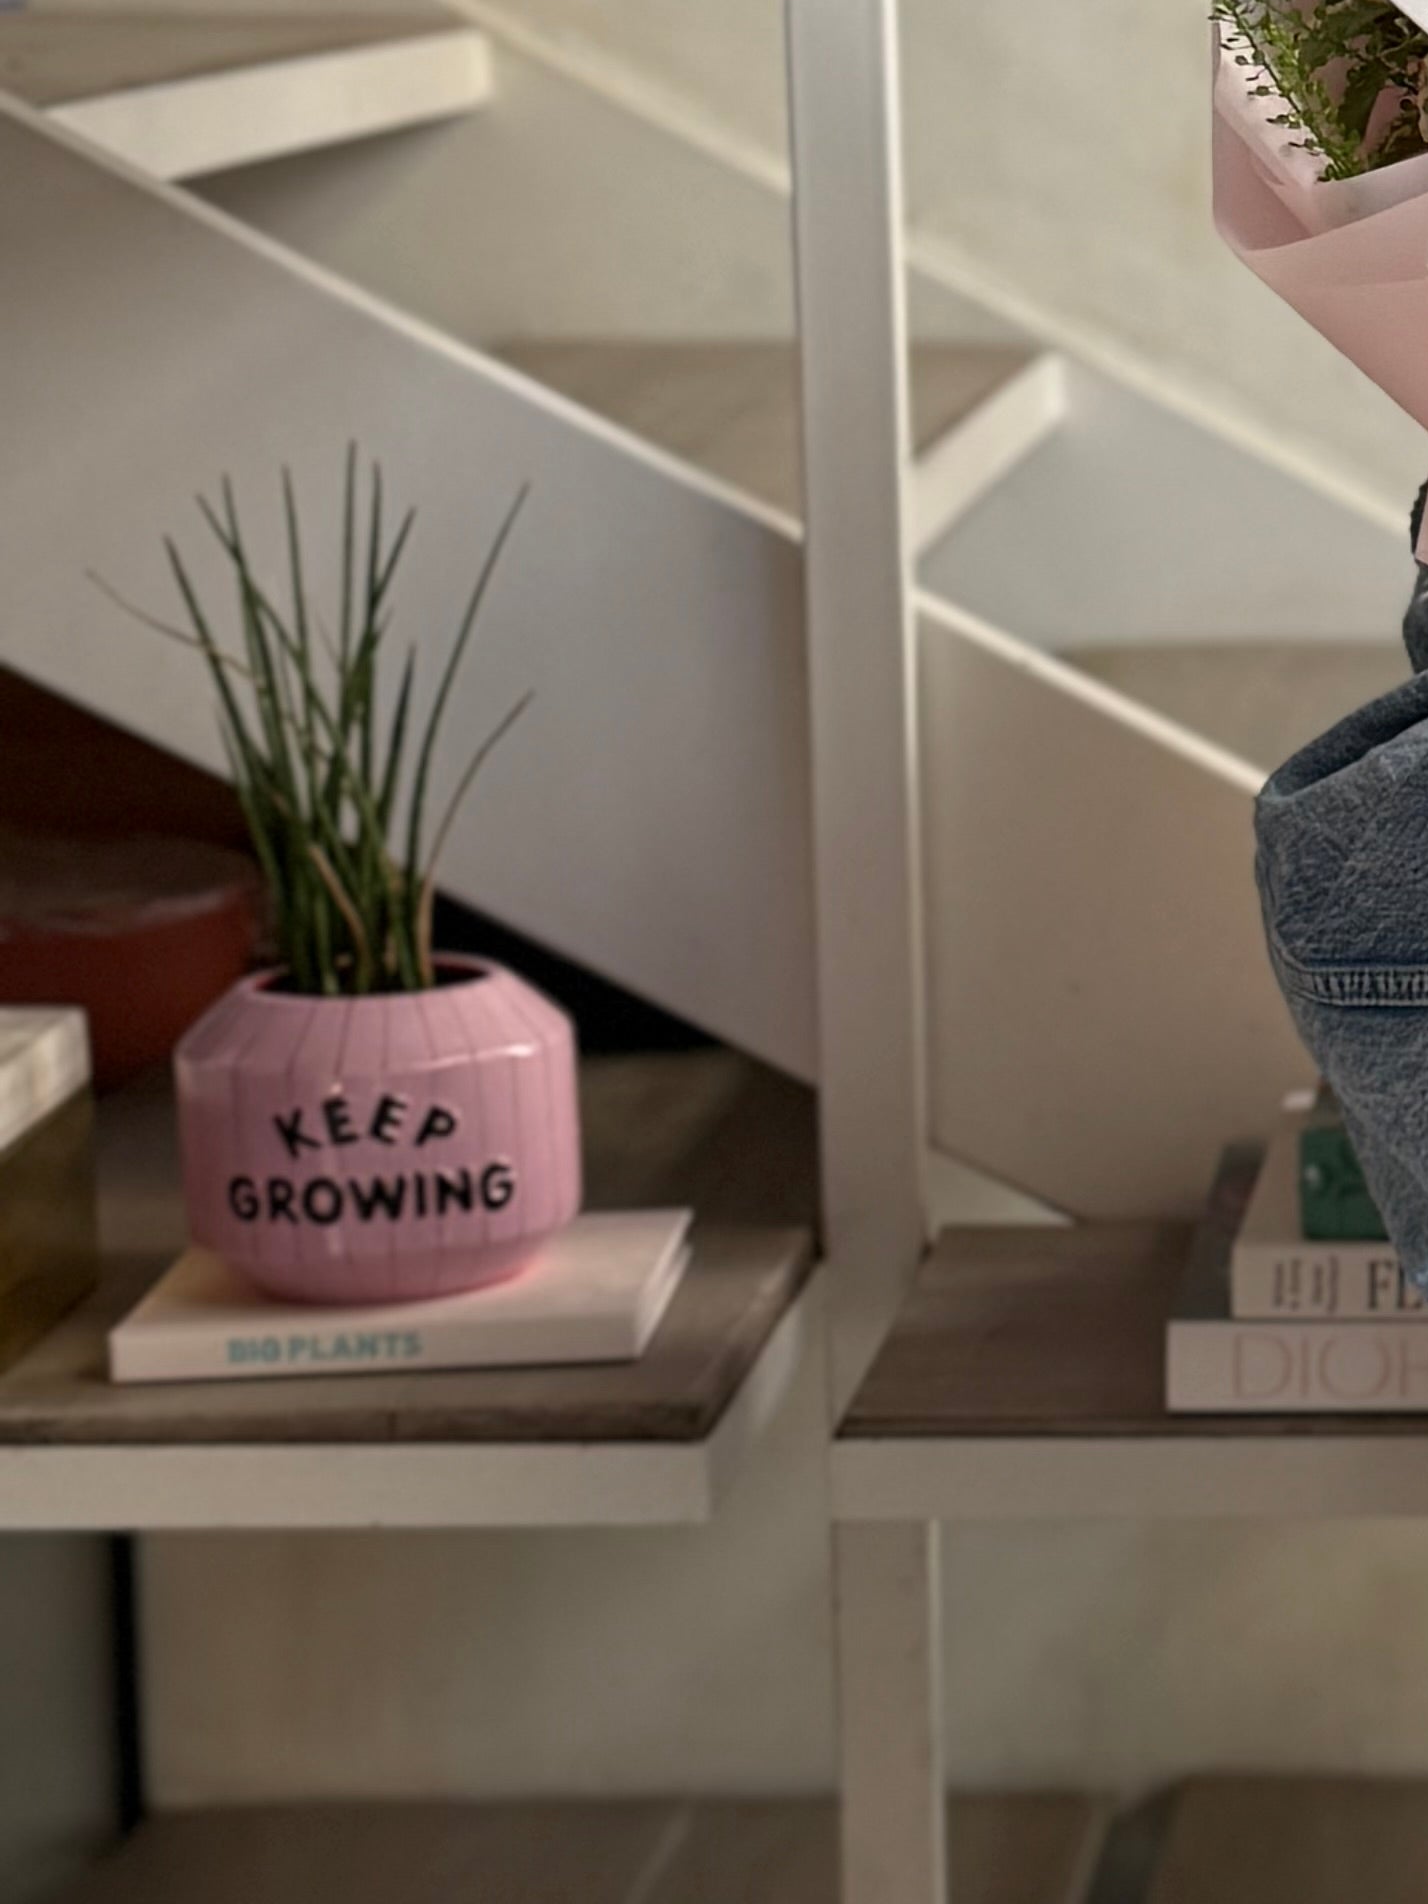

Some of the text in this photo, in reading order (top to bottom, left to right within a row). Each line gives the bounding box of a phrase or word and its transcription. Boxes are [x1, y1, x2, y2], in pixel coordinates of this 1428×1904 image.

[273, 1093, 460, 1159] KEEP
[227, 1162, 515, 1225] GROWING
[287, 1332, 424, 1361] PLANTS
